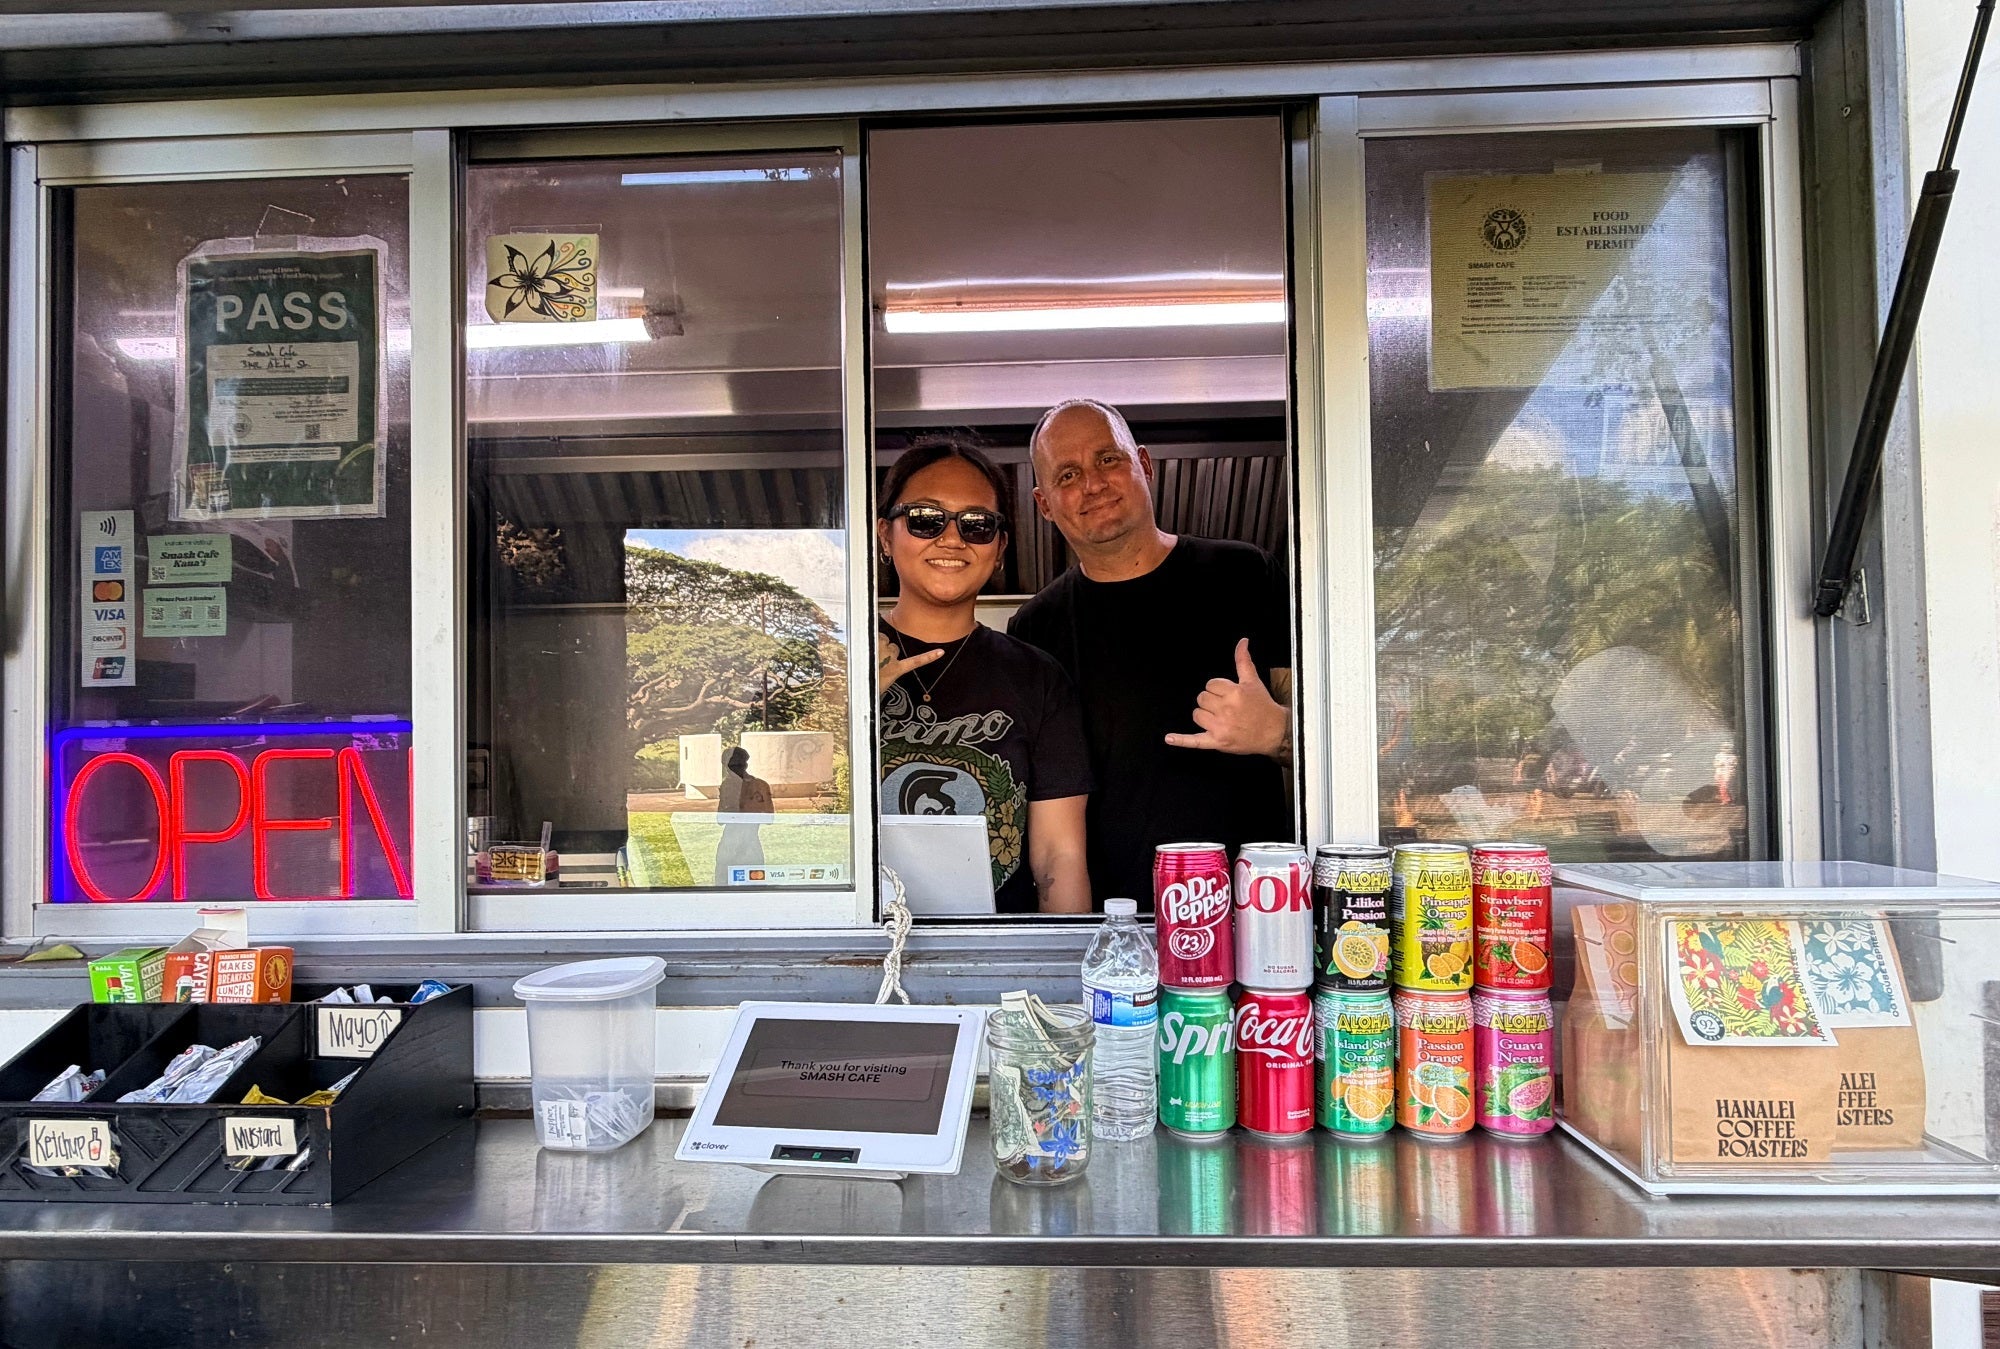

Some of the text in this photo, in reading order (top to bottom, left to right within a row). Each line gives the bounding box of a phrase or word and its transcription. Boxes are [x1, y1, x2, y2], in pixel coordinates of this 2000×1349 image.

[1592, 211, 1629, 222] FOOD
[1586, 239, 1637, 250] PERMIT
[216, 291, 348, 332] PASS
[101, 551, 122, 560] AM
[160, 549, 220, 560] Smash Cafe
[104, 560, 122, 569] EX
[94, 608, 126, 622] VISA
[65, 747, 414, 902] OPEN
[1335, 871, 1390, 890] ALOHA
[1416, 869, 1471, 889] ALOHA
[1481, 869, 1541, 888] ALOHA
[1187, 876, 1217, 903] Dr
[1161, 883, 1229, 925] Pepper
[1345, 897, 1385, 908] Lilikoi
[1420, 894, 1471, 908] Pineapple
[1480, 893, 1543, 906] Strawberry
[1342, 908, 1386, 920] Passion
[1426, 908, 1467, 920] Orange
[1489, 906, 1535, 919] Orange
[1181, 934, 1200, 951] 23
[219, 961, 253, 971] MAKES
[217, 972, 255, 985] BREAKFAST
[1879, 967, 1896, 1001] HOUSE
[217, 983, 253, 995] LUNCH &
[1788, 947, 1829, 1042] HANALEI SUNRISE
[1336, 1012, 1391, 1032] ALOHA
[1409, 1012, 1468, 1031] ALOHA
[1489, 1012, 1548, 1031] ALOHA
[1700, 1019, 1715, 1031] 92
[329, 1012, 377, 1049] Mayo
[1160, 1007, 1236, 1065] Spri
[1334, 1038, 1393, 1050] Island Style
[1417, 1038, 1464, 1051] Passion
[1499, 1038, 1544, 1050] Guava
[1345, 1051, 1386, 1063] Orange
[1417, 1051, 1464, 1064] Orange
[1497, 1051, 1545, 1063] Nectar
[781, 1060, 907, 1075] Thank you for visiting
[1265, 1061, 1305, 1069] ORIGINAL
[799, 1071, 881, 1083] SMASH CAFE
[1716, 1099, 1795, 1119] HANALEI
[1716, 1119, 1796, 1138] COFFEE
[33, 1123, 86, 1163] Ketchup
[232, 1124, 283, 1151] Mustard
[700, 1141, 729, 1151] clover
[1717, 1138, 1809, 1158] ROASTERS
